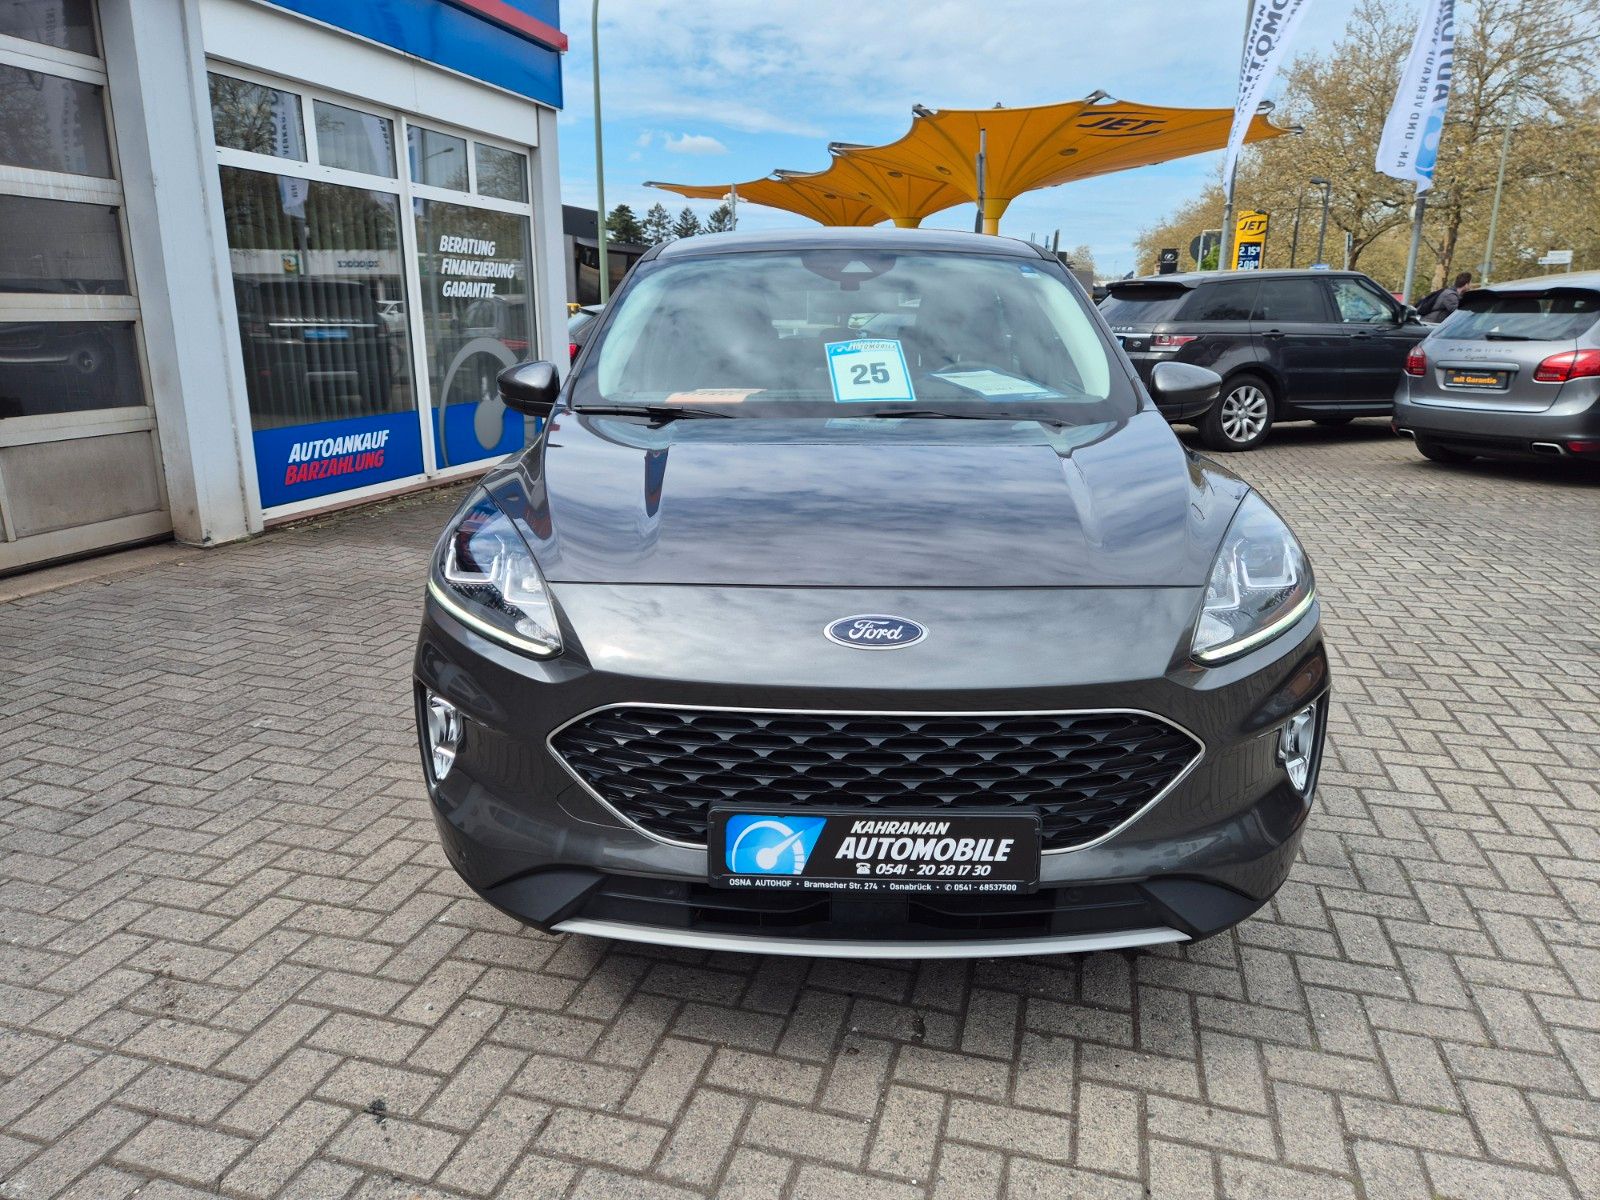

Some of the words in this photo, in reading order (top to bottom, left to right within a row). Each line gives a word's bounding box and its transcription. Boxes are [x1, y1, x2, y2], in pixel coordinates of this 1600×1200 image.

[1076, 117, 1168, 131] JET
[1239, 220, 1267, 231] JET
[439, 234, 497, 257] BERATUNG
[441, 257, 515, 279] FINANZIERUNG
[442, 280, 497, 299] GARANTIE
[850, 362, 891, 386] 25
[1466, 376, 1498, 385] Garantie
[288, 429, 390, 464] AUTOANKAUF
[285, 449, 385, 487] BARZAHLUNG
[848, 619, 903, 640] Ford
[850, 821, 950, 836] KAHRAMAN
[834, 836, 1015, 862] AUTOMOBILE
[875, 863, 908, 876] 0541
[916, 864, 936, 876] 20
[937, 864, 957, 876] 28
[957, 864, 972, 876] 17
[972, 865, 992, 877] 30
[729, 878, 752, 887] OSNA
[755, 879, 792, 888] AUTOHOF
[804, 880, 847, 890] Bramscher
[849, 881, 863, 890] Str.
[864, 882, 878, 890] 274
[889, 882, 932, 891] Osnabrück
[953, 884, 972, 892] 0541
[978, 884, 1017, 892] 68537500
